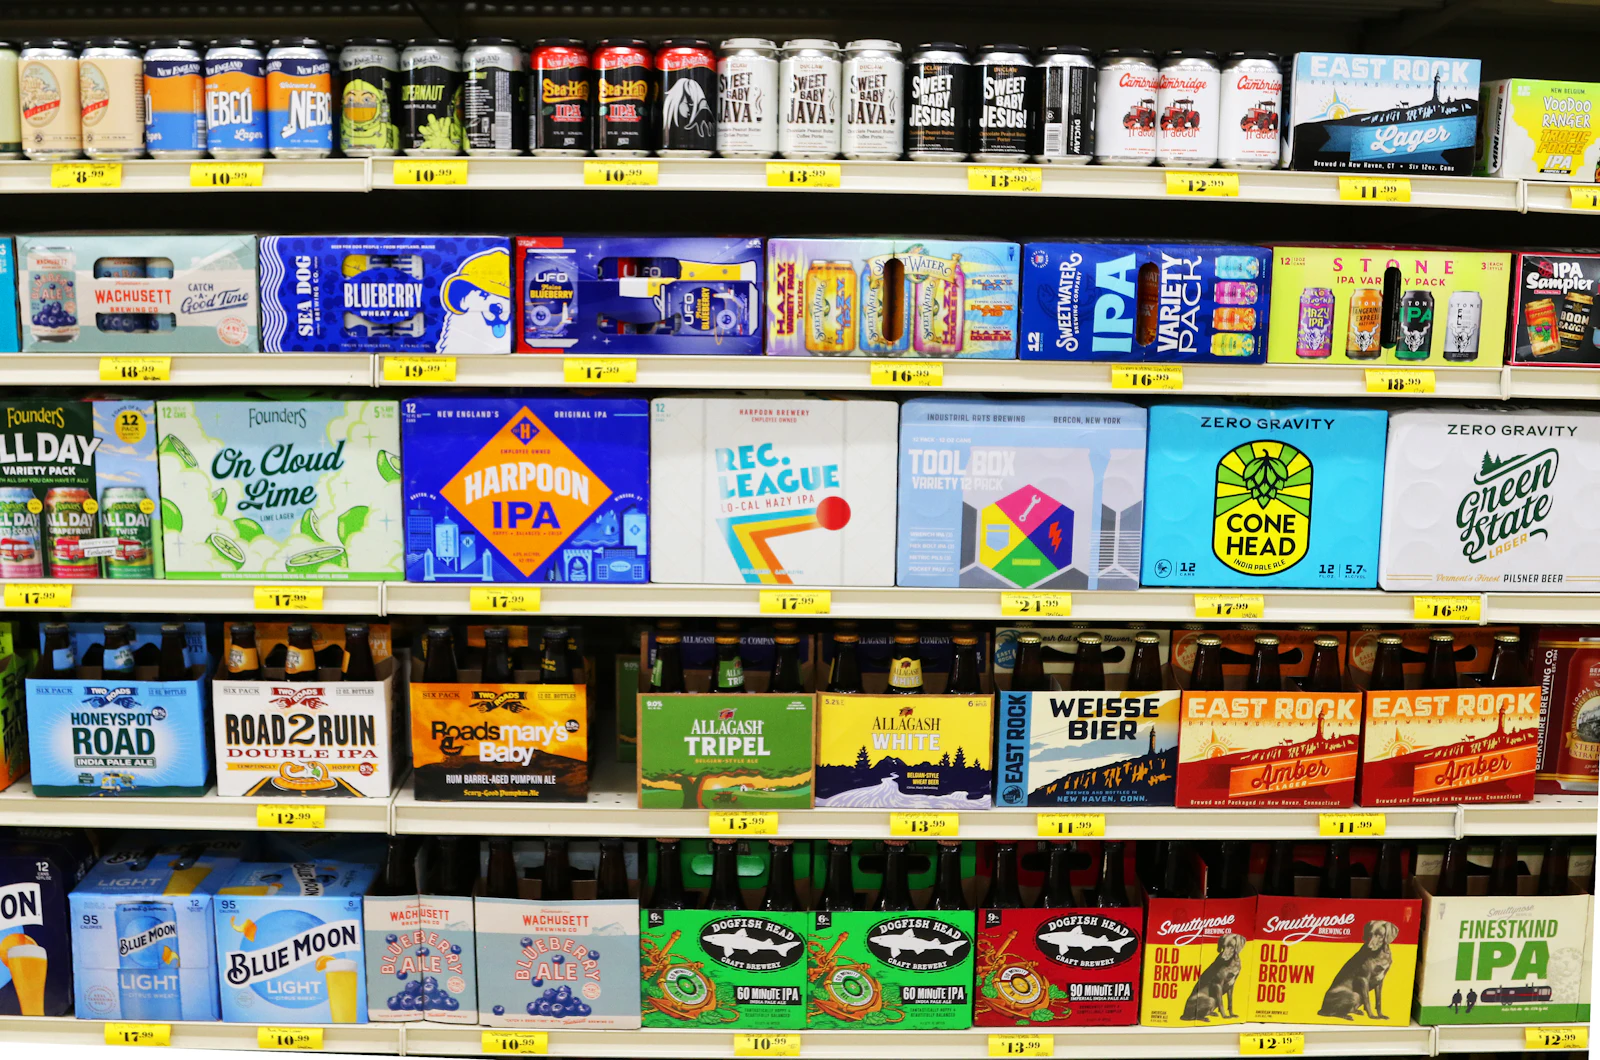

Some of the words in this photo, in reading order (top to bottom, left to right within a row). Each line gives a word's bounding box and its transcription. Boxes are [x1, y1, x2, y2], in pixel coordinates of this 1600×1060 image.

[1310, 55, 1386, 79] EAST
[1393, 58, 1470, 83] ROCK
[792, 74, 827, 93] SWEET
[985, 77, 1026, 100] SWEET
[800, 89, 825, 102] BABY
[995, 93, 1024, 110] BABY
[1543, 96, 1592, 113] VOODOO
[787, 98, 827, 124] JAVA
[980, 105, 1027, 128] JESUS!
[1542, 113, 1591, 128] RANGER
[1370, 124, 1451, 154] Lager
[1540, 129, 1592, 143] TROPIC
[1537, 142, 1586, 155] FORCE
[1544, 155, 1573, 169] IPA
[296, 255, 312, 295] DOG
[1333, 257, 1454, 274] STONE
[1553, 262, 1583, 278] IPA
[188, 283, 214, 292] CATCH
[535, 273, 568, 283] UFO
[1336, 276, 1355, 285] IPA
[1360, 277, 1410, 287] VARY
[1416, 278, 1446, 287] PACK
[1526, 273, 1594, 295] Sampler
[95, 289, 172, 305] WACHUSETT
[181, 297, 214, 314] Good
[217, 288, 249, 305] Time
[344, 283, 423, 309] BLUEBERRY
[530, 290, 574, 300] BLUEBERRY
[1056, 252, 1082, 352] SWEETWATER
[1092, 252, 1136, 353] IPA
[1157, 252, 1183, 353] VARIETY
[1179, 255, 1202, 353] PACK
[298, 300, 314, 337] SEA
[360, 310, 391, 318] WHEAT
[394, 310, 409, 318] ALE
[7, 407, 65, 430] Founders
[249, 408, 306, 429] Founders
[437, 411, 453, 419] NEW
[456, 411, 499, 419] ENGLAND'S
[554, 411, 591, 419] ORIGINAL
[594, 411, 607, 419] IPA
[739, 409, 773, 417] HARPOON
[927, 414, 969, 423] INDUSTRIAL
[973, 414, 990, 423] ARTS
[993, 415, 1025, 424] BREWING
[1447, 424, 1496, 436] ZERO
[1501, 425, 1578, 437] GRAVITY
[212, 448, 255, 480] On
[261, 440, 345, 476] Cloud
[715, 443, 791, 472] REC.
[908, 449, 966, 475] TOOL
[972, 450, 1016, 477] BOX
[3, 466, 47, 477] VARIETY
[49, 466, 76, 477] PACK
[464, 462, 589, 507] HARPOON
[718, 464, 840, 500] LEAGUE
[912, 477, 958, 491] VARIETY
[961, 477, 972, 491] 12
[974, 478, 1003, 492] PACK
[238, 477, 316, 511] Lime
[721, 499, 759, 513] LO-CAL
[766, 497, 792, 509] HAZY
[798, 495, 815, 506] IPA
[1456, 452, 1557, 545] Green
[492, 501, 561, 530] IPA
[1227, 513, 1296, 535] CONE
[1462, 494, 1554, 562] State
[1226, 537, 1296, 557] HEAD
[1489, 533, 1528, 559] LAGER
[1233, 558, 1254, 571] INDIA
[1254, 562, 1272, 572] PALE
[1273, 559, 1286, 570] ALE
[1504, 574, 1539, 583] PILSNER
[1542, 574, 1563, 583] BEER
[1007, 695, 1026, 741] ROCK
[1050, 698, 1160, 718] WEISSE
[1188, 698, 1268, 720] EAST
[1275, 698, 1356, 722] ROCK
[71, 713, 152, 727] HONEYSPOT
[225, 714, 285, 746] ROAD
[289, 713, 315, 747] 2
[319, 714, 376, 747] RUIN
[691, 719, 763, 735] ALLAGASH
[872, 717, 941, 731] ALLAGASH
[431, 721, 569, 747] Roadsmary's
[1069, 721, 1138, 741] BIER
[73, 728, 155, 756] ROAD
[684, 737, 771, 757] TRIPEL
[871, 733, 940, 752] WHITE
[133, 759, 154, 767] ALE
[227, 749, 329, 759] DOUBLE
[337, 749, 378, 759] IPA
[479, 740, 535, 768] Baby
[1006, 743, 1024, 784] EAST
[446, 775, 462, 785] RUM
[464, 775, 509, 785] BARREL-AGED
[510, 775, 542, 785] PUMPKIN
[544, 775, 556, 785] ALE
[1251, 761, 1330, 791] Amber
[1081, 796, 1116, 804] HAVEN,
[523, 915, 589, 928] WACHUSETT
[713, 919, 762, 932] DOGFISH
[766, 923, 795, 941] HEAD
[1263, 913, 1355, 946] Smuttynose
[1460, 920, 1558, 940] FINESTKIND
[228, 947, 289, 986] BLUE
[294, 925, 356, 962] MOON
[515, 937, 600, 981] BLUEBERRY
[1260, 944, 1288, 962] OLD
[1455, 941, 1550, 982] IPA
[537, 963, 578, 981] ALE
[721, 957, 744, 969] CRAFT
[746, 961, 781, 970] BREWERY
[1259, 964, 1314, 984] BROWN
[267, 981, 321, 995] LIGHT
[737, 987, 749, 1000] 60
[751, 987, 780, 1000] MINUTE
[783, 987, 799, 1001] IPA
[1070, 984, 1082, 997] 90
[1085, 984, 1113, 997] MINUTE
[1115, 984, 1130, 997] IPA
[1256, 985, 1285, 1003] DOG
